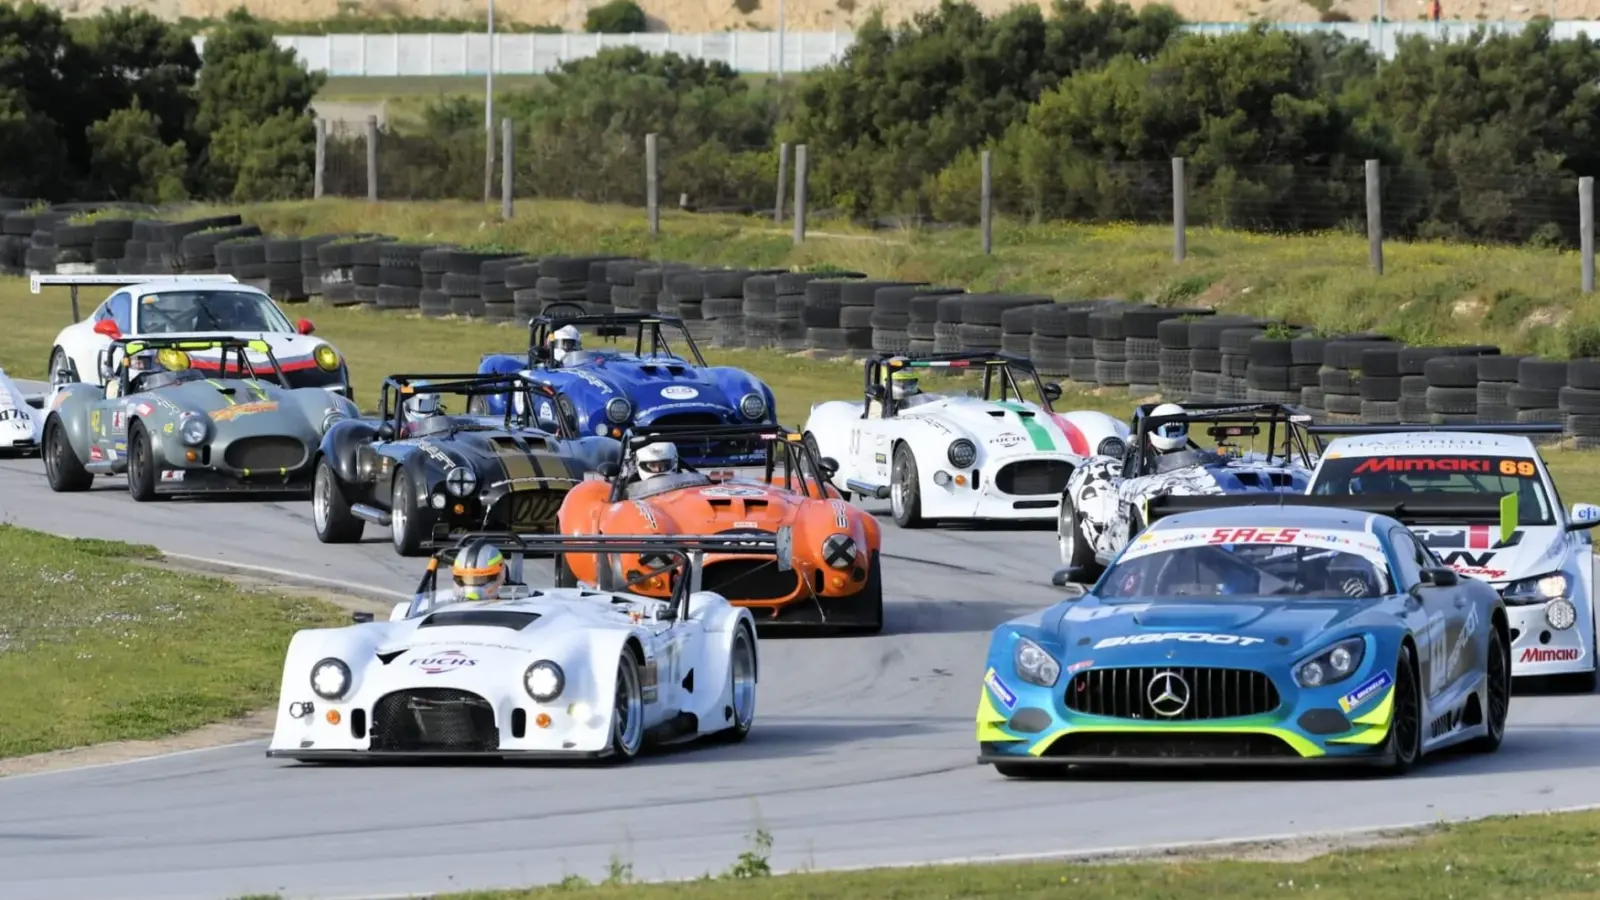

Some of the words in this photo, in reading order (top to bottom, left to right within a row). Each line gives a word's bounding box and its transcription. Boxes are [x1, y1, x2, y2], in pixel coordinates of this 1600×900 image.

[1352, 457, 1490, 475] Mimaki
[1499, 459, 1535, 477] 69
[1093, 632, 1265, 650] BIGFOOT
[409, 657, 480, 667] FUCHS
[1519, 648, 1579, 663] Mimaki
